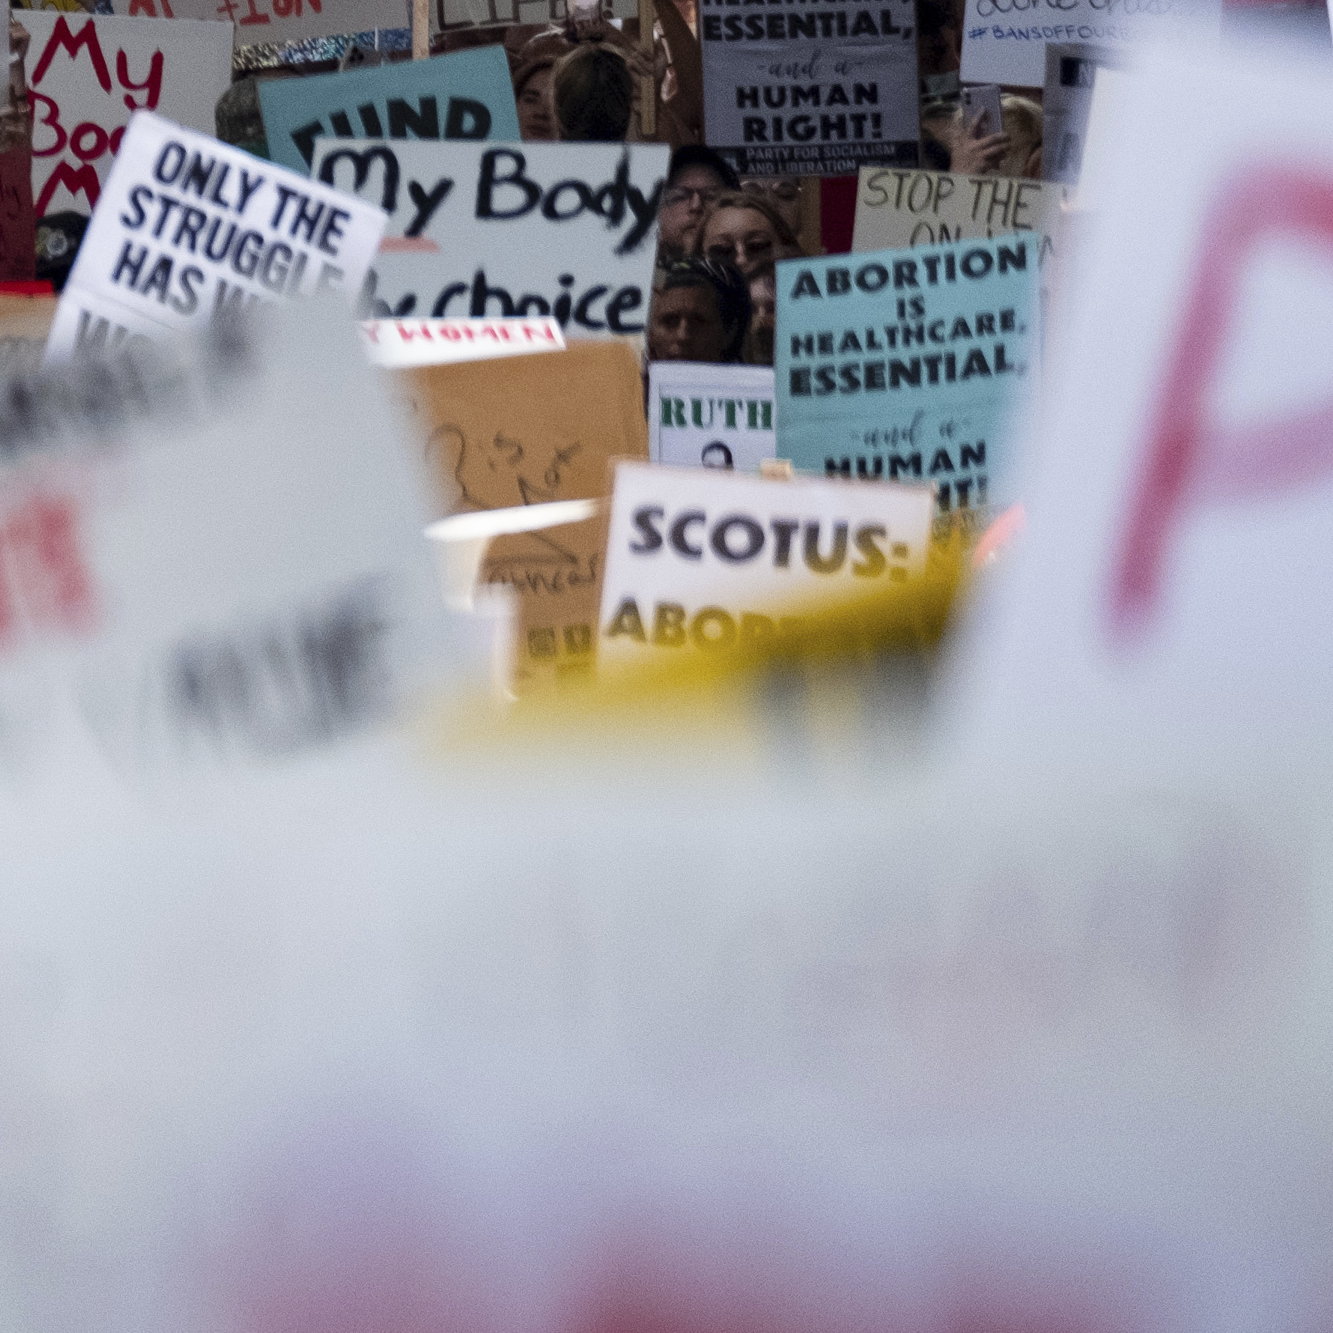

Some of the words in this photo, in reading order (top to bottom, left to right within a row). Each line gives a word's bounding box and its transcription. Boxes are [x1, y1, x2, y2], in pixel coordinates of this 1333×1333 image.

[703, 9, 913, 43] ESSENTIAL,
[32, 16, 165, 110] My
[737, 84, 878, 109] HUMAN
[743, 114, 883, 144] RIGHT!
[152, 142, 265, 208] ONLY
[276, 185, 352, 257] THE
[316, 145, 454, 236] My
[475, 145, 668, 257] Body
[863, 171, 955, 213] STOP
[969, 179, 1040, 231] THE
[790, 241, 1029, 299] ABORTION
[789, 308, 1027, 360] HEALTHCARE,
[897, 295, 925, 323] IS
[659, 397, 774, 430] RUTH
[629, 506, 910, 582] SCOTUS:
